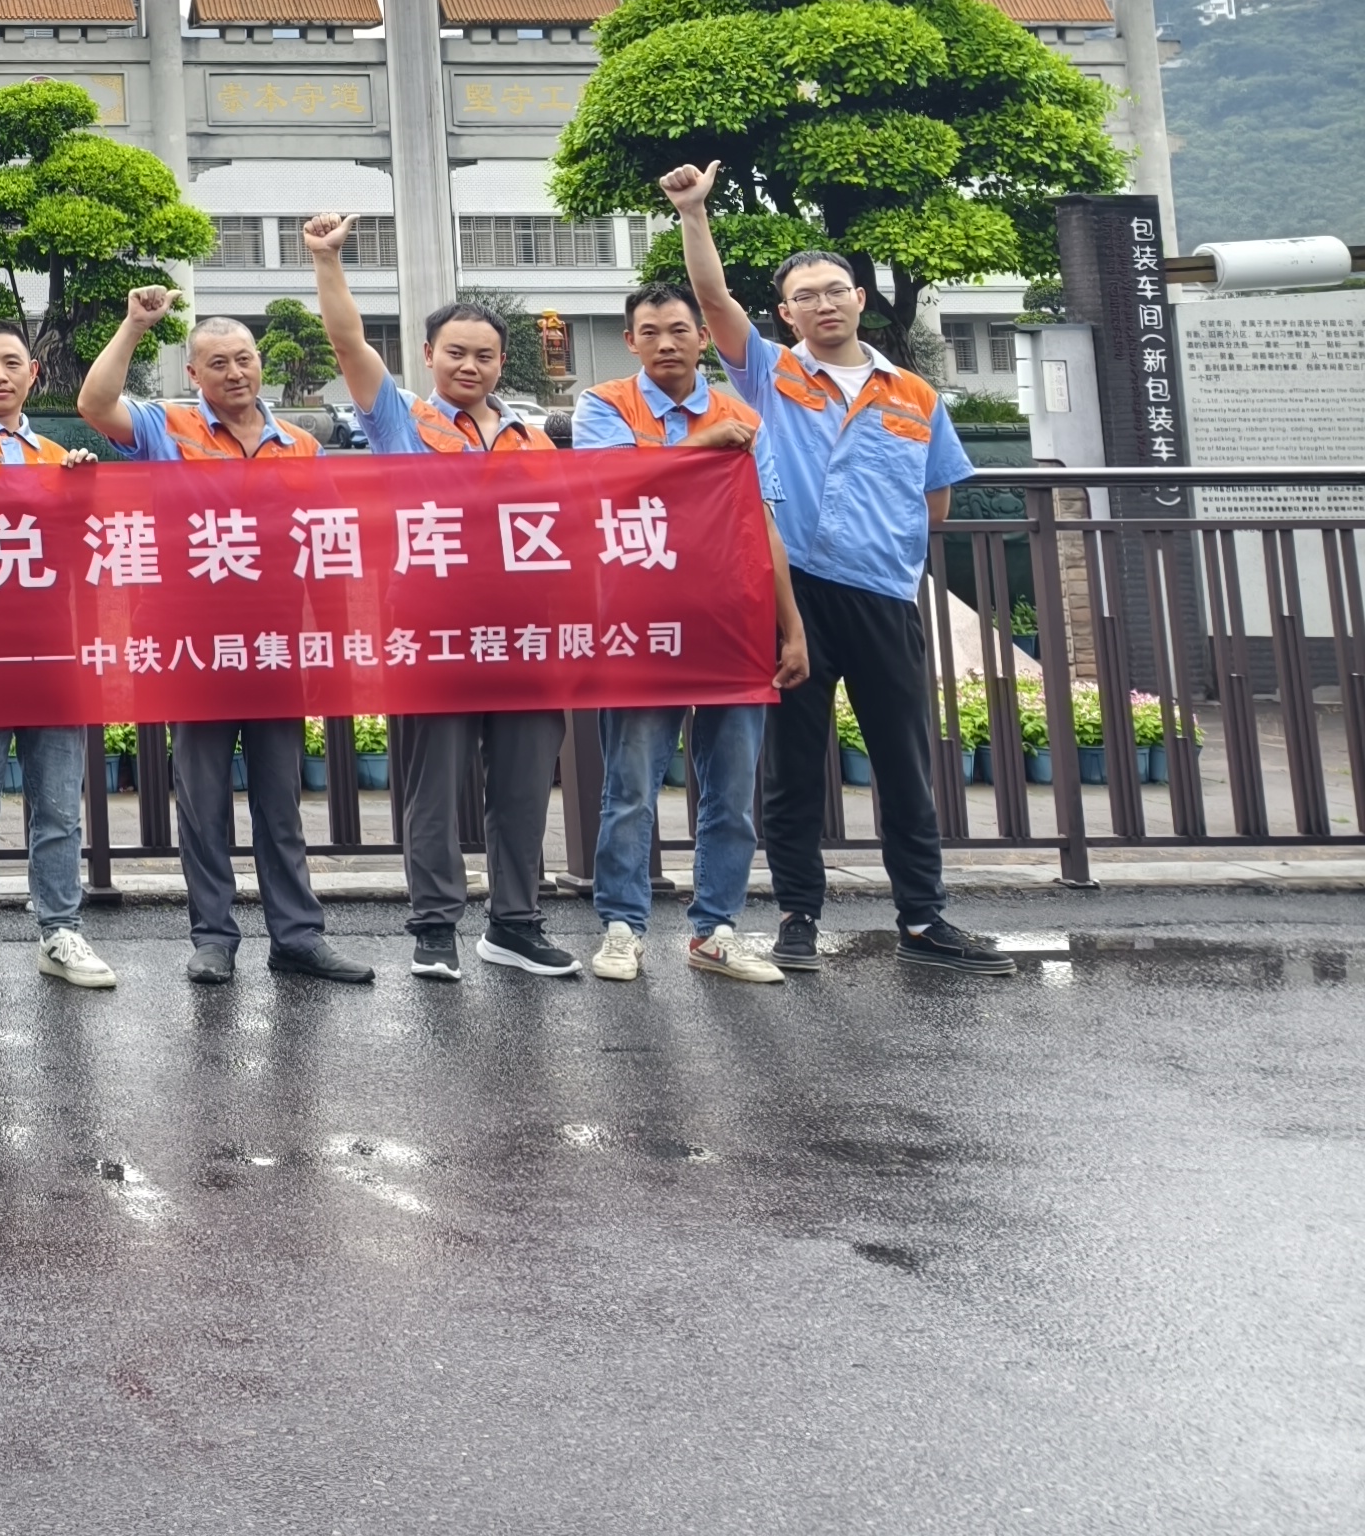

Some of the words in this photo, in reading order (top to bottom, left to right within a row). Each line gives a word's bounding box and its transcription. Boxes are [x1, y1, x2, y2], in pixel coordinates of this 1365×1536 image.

[463, 83, 587, 115] 堅守工
[1131, 216, 1181, 506] 包装车间（新包装车）
